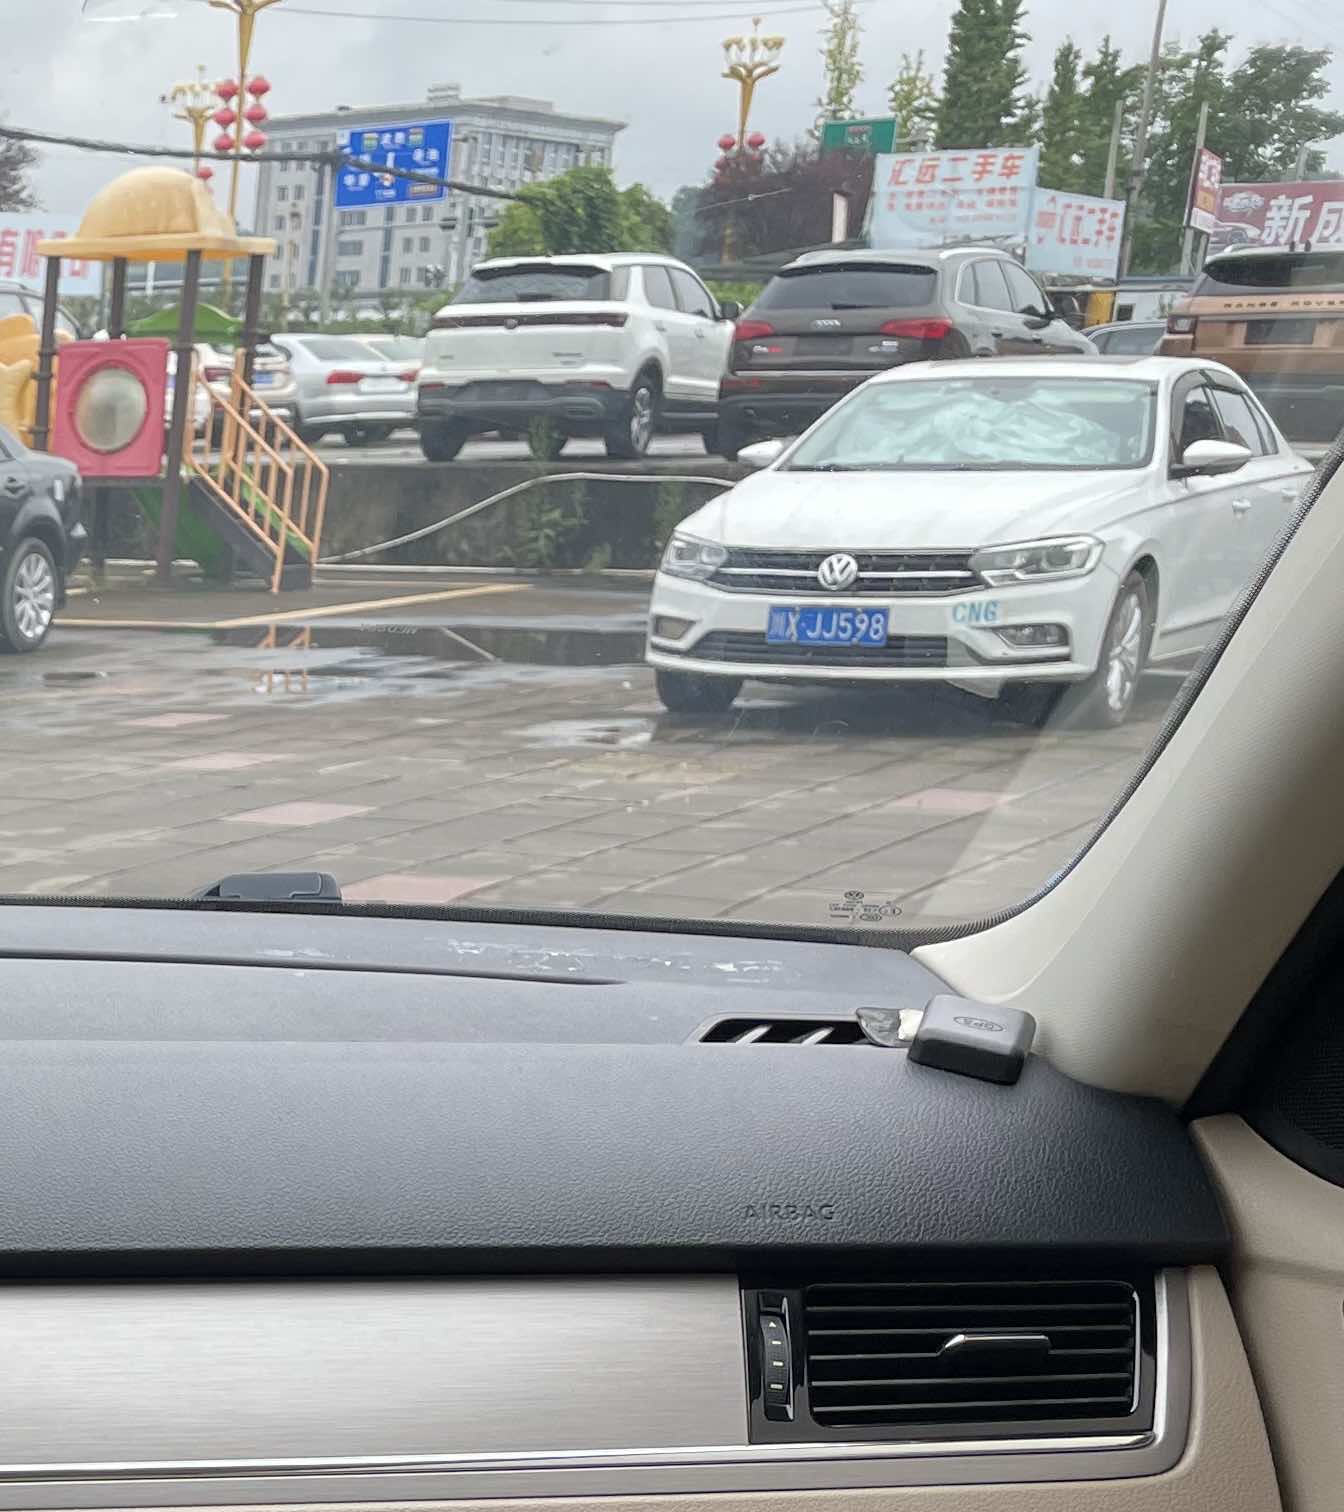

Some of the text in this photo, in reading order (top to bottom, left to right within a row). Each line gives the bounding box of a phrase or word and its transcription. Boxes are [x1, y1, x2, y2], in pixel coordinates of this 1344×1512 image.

[888, 154, 1025, 186] 汇远二手车
[952, 600, 1000, 623] CNG
[742, 1204, 835, 1220] AIRBAG
